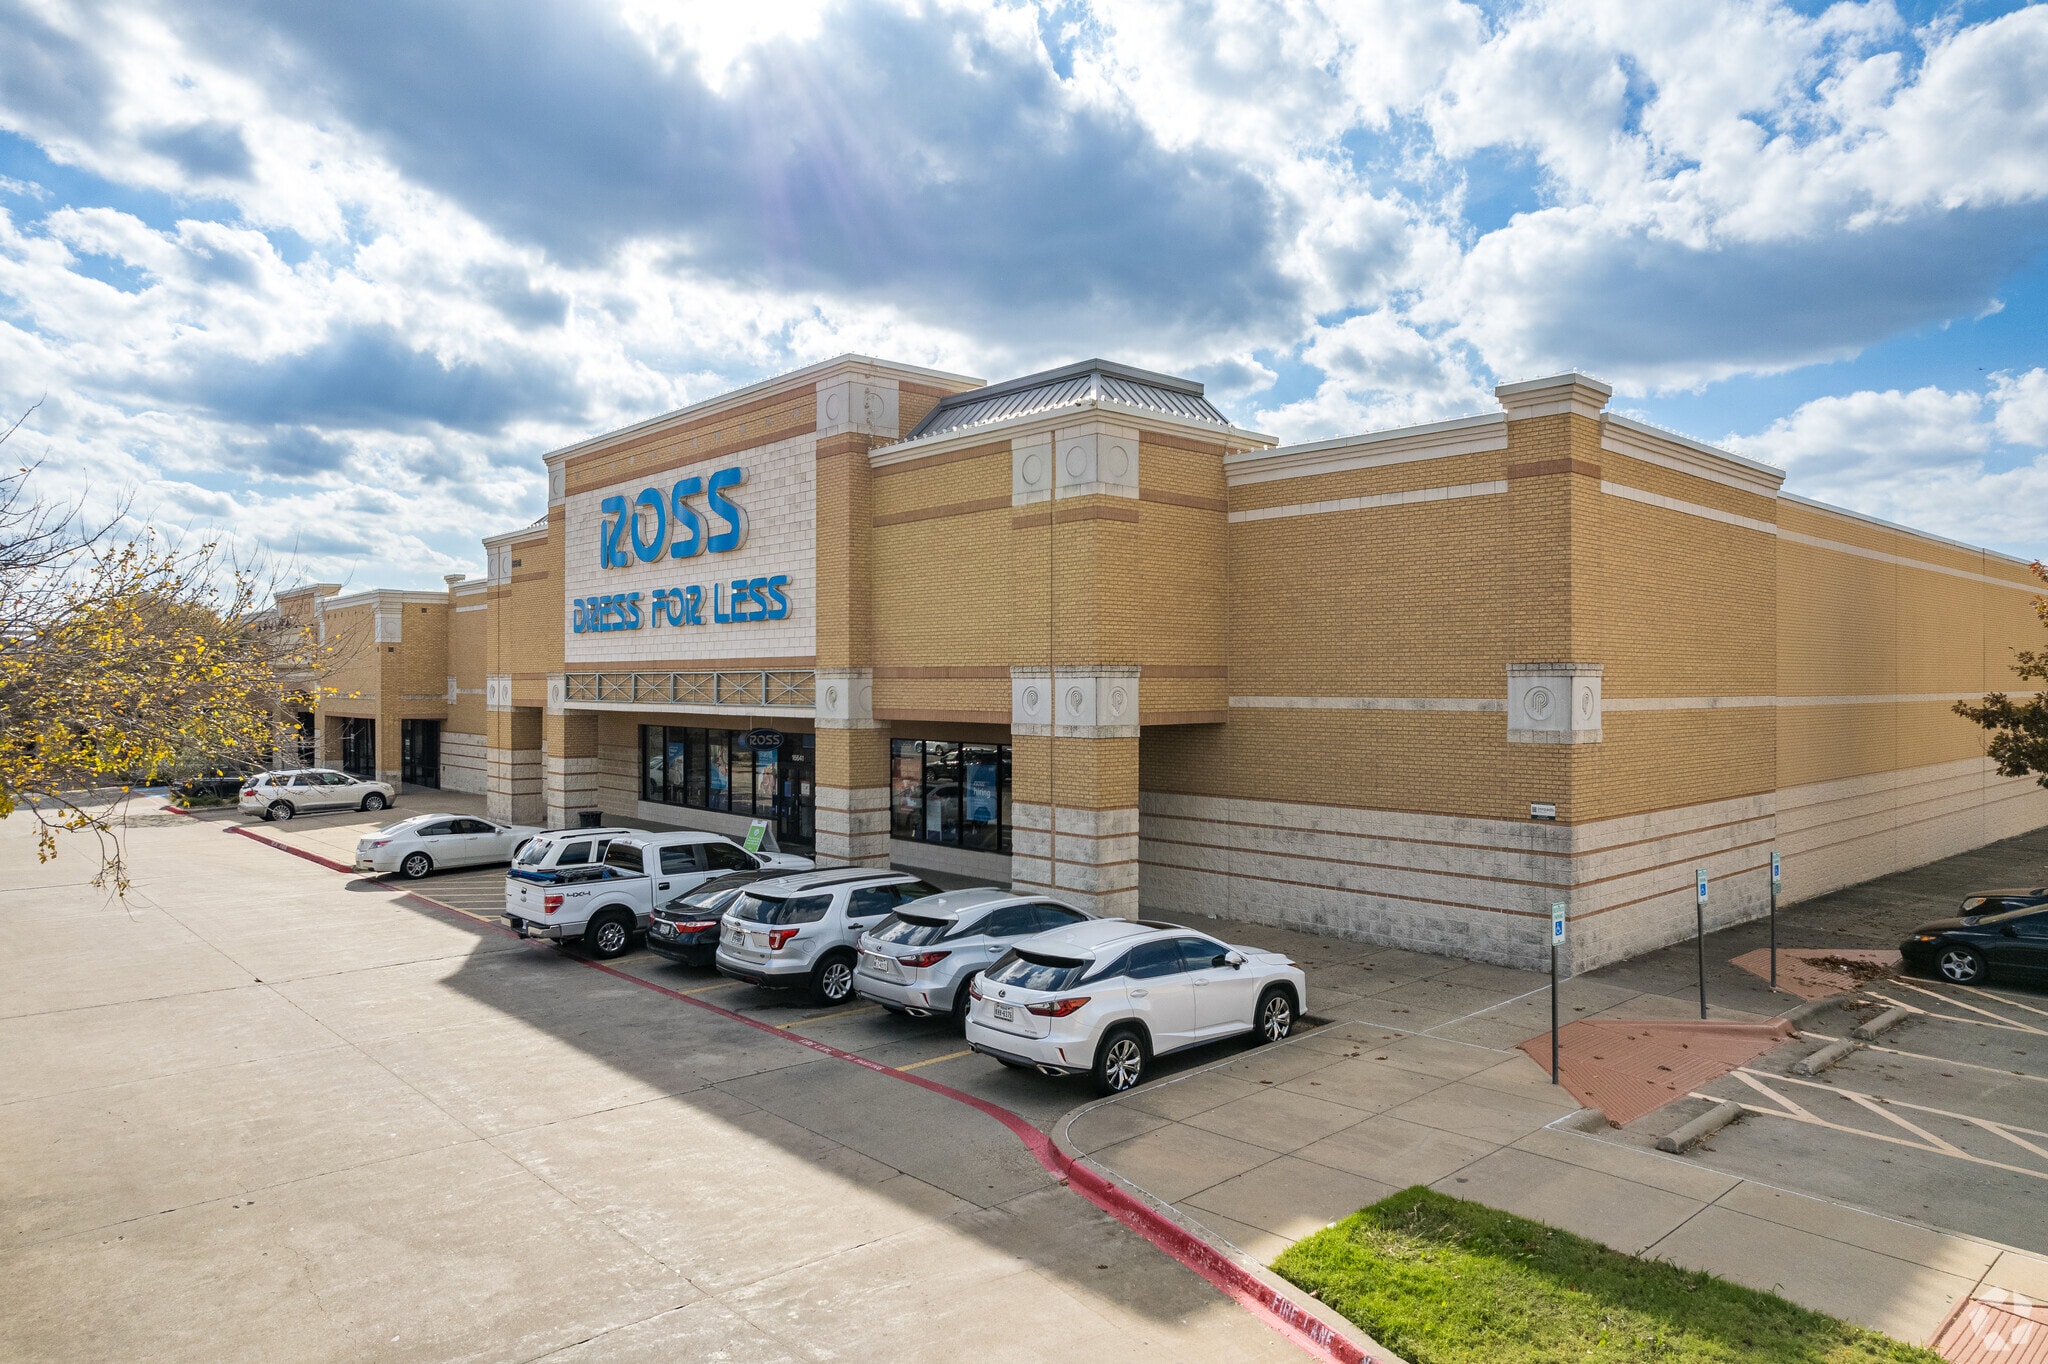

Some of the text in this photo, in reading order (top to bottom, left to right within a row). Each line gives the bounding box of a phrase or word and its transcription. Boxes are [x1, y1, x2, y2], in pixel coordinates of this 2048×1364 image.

[601, 466, 749, 569] ROSS
[573, 574, 793, 633] DRESS FOR LESS
[750, 735, 780, 745] ROSS
[1271, 1294, 1300, 1323] FIRE
